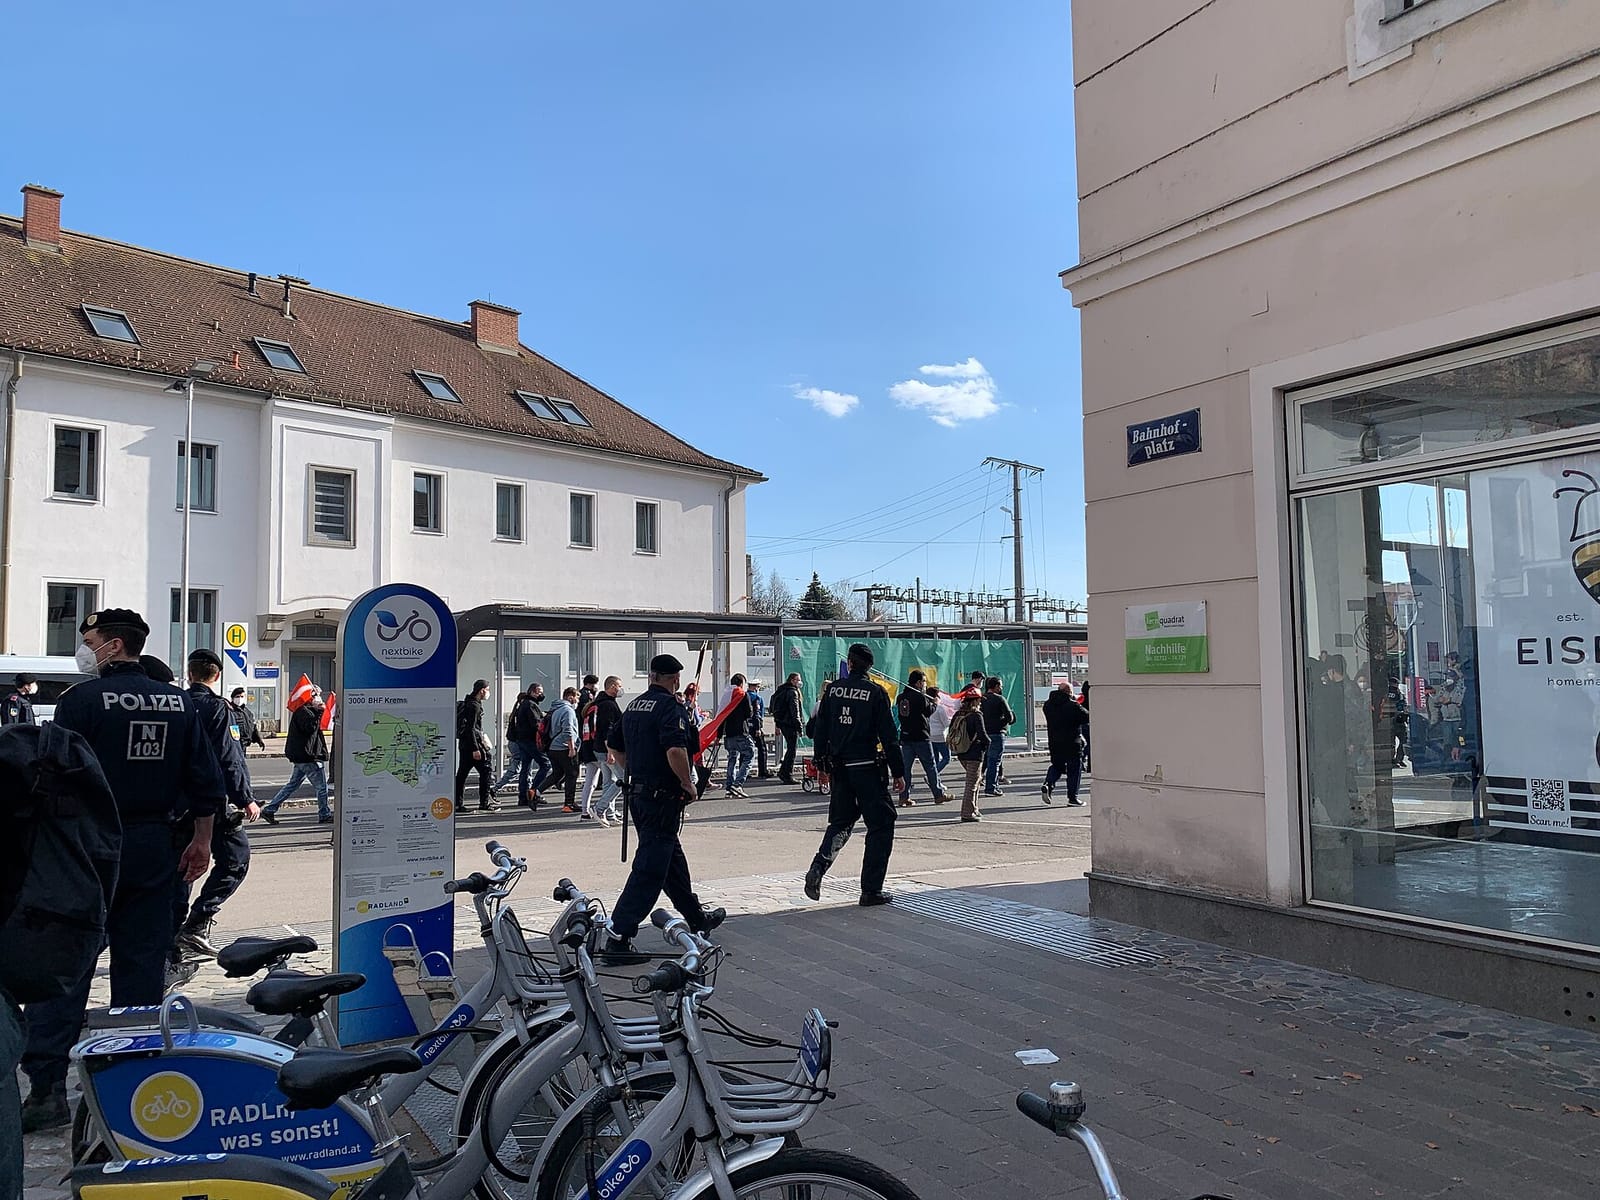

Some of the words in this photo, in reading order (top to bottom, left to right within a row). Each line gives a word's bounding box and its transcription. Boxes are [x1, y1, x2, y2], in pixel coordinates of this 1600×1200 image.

[1144, 439, 1175, 459] platz
[1556, 612, 1584, 622] est.
[231, 628, 242, 643] H
[381, 646, 424, 656] nextbike
[1145, 643, 1186, 655] Nachhilfe
[829, 686, 871, 701] POLIZEI
[102, 692, 185, 712] POLIZEI
[628, 699, 657, 712] OLIZEI
[842, 706, 851, 716] N
[838, 715, 853, 725] 120
[141, 725, 157, 740] N
[134, 742, 160, 756] 103
[1530, 814, 1551, 826] Scan
[1552, 817, 1570, 828] me!
[368, 901, 404, 909] RADLAND
[220, 1132, 263, 1151] was
[271, 1118, 340, 1144] sonst!
[281, 1143, 362, 1162] www.radland.at
